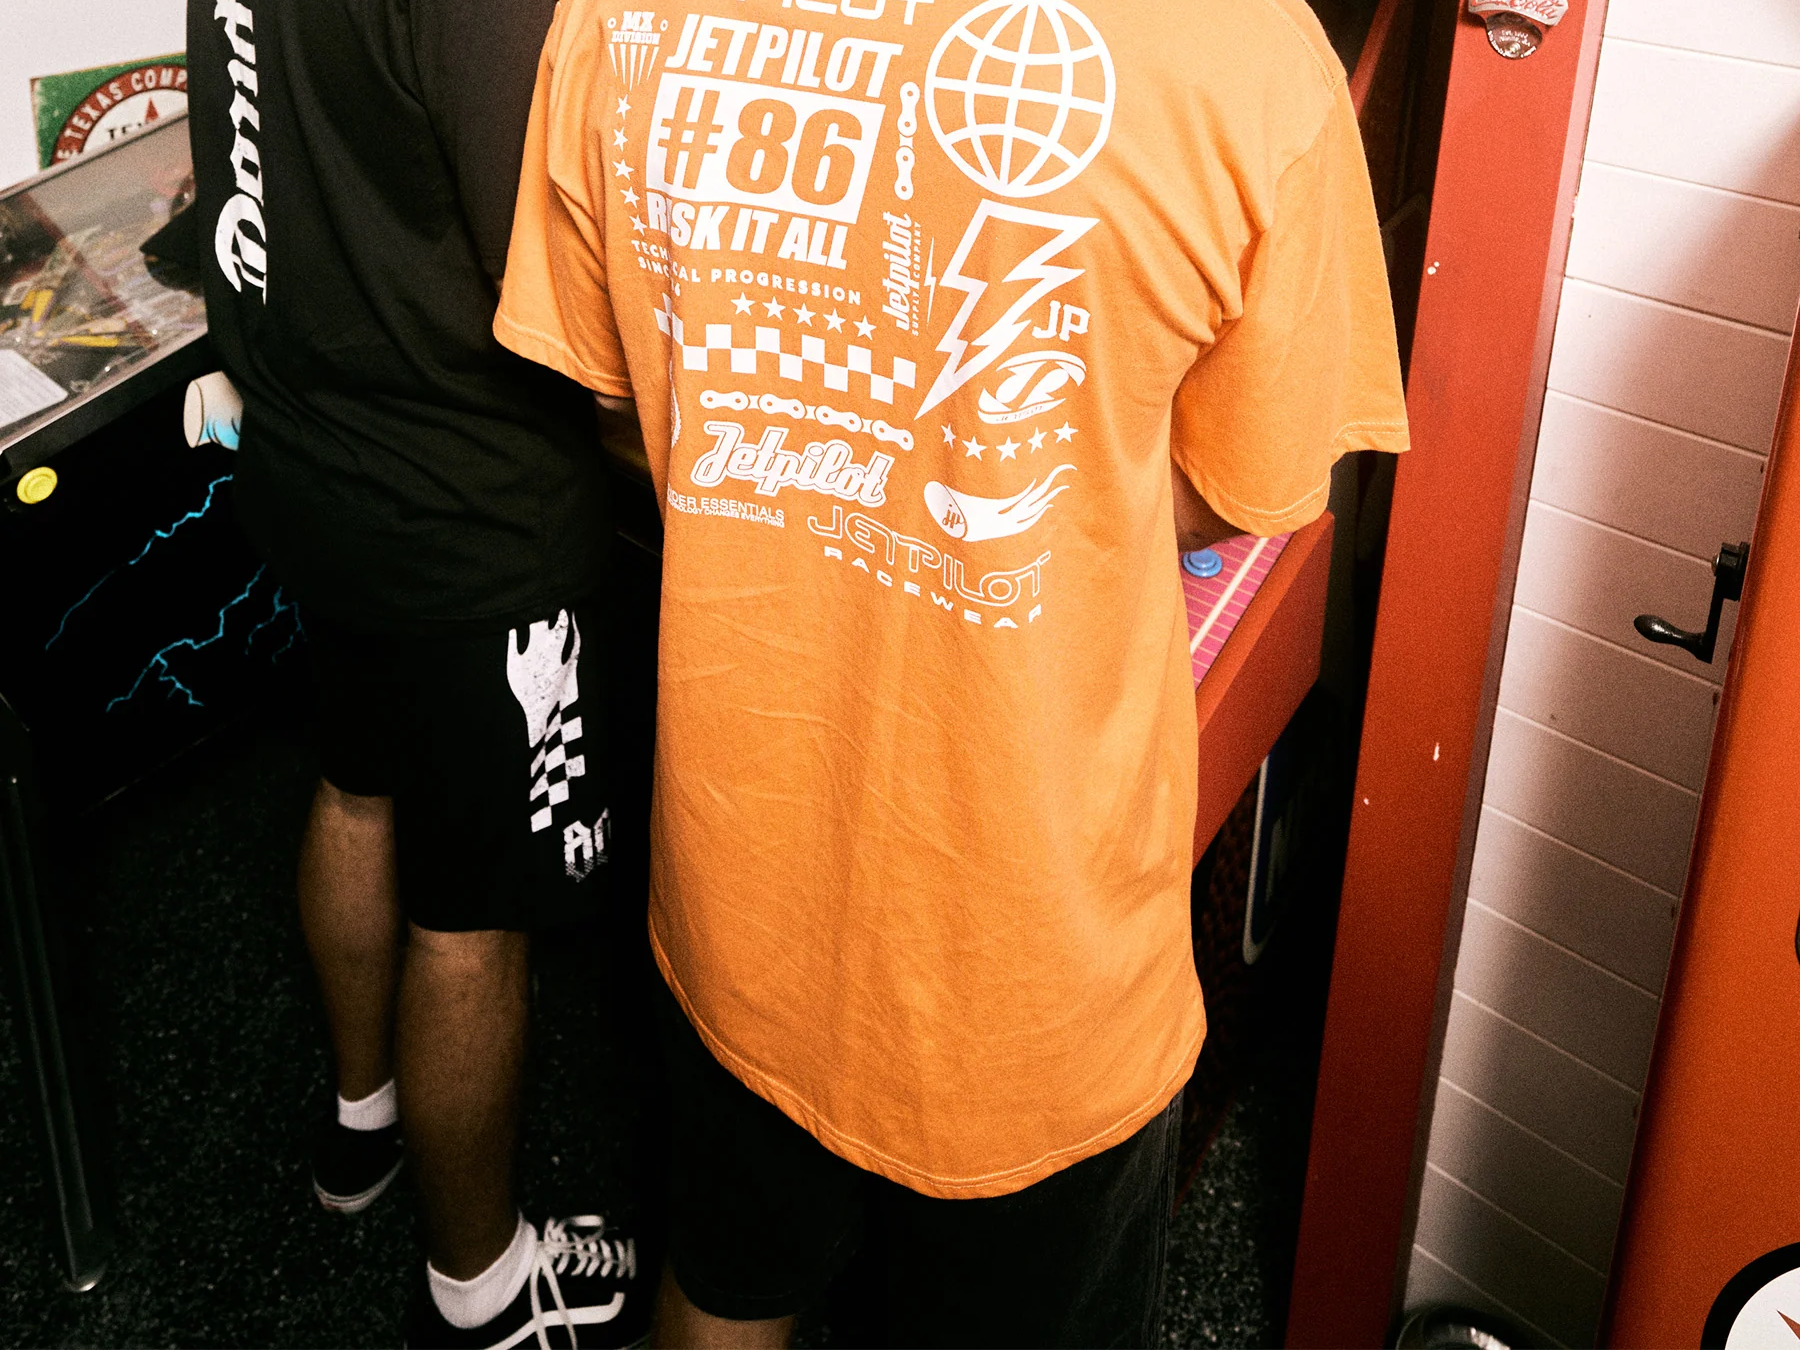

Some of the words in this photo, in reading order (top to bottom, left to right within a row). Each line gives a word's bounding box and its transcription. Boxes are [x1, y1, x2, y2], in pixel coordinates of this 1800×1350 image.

[611, 30, 661, 45] DIVISION
[621, 11, 655, 32] MX
[665, 13, 904, 99] JETPILOT
[64, 81, 124, 140] TEXAS
[131, 68, 187, 91] COMP
[657, 86, 863, 206] #86
[646, 191, 731, 251] RISK
[730, 207, 780, 254] IT
[777, 216, 849, 271] ALL
[912, 221, 922, 279] COMPANY
[710, 268, 861, 306] PROGRESSION
[882, 211, 919, 331] Jetpilot
[911, 290, 920, 337] SUPPLY
[1031, 300, 1091, 342] JP
[690, 420, 896, 508] Jetpilot
[701, 497, 785, 521] ESSENTIALS
[704, 508, 740, 519] CHANGES
[741, 512, 785, 528] EVERYTHING
[807, 505, 1051, 607] JETPILOT
[824, 546, 1043, 629] RACEWEAR
